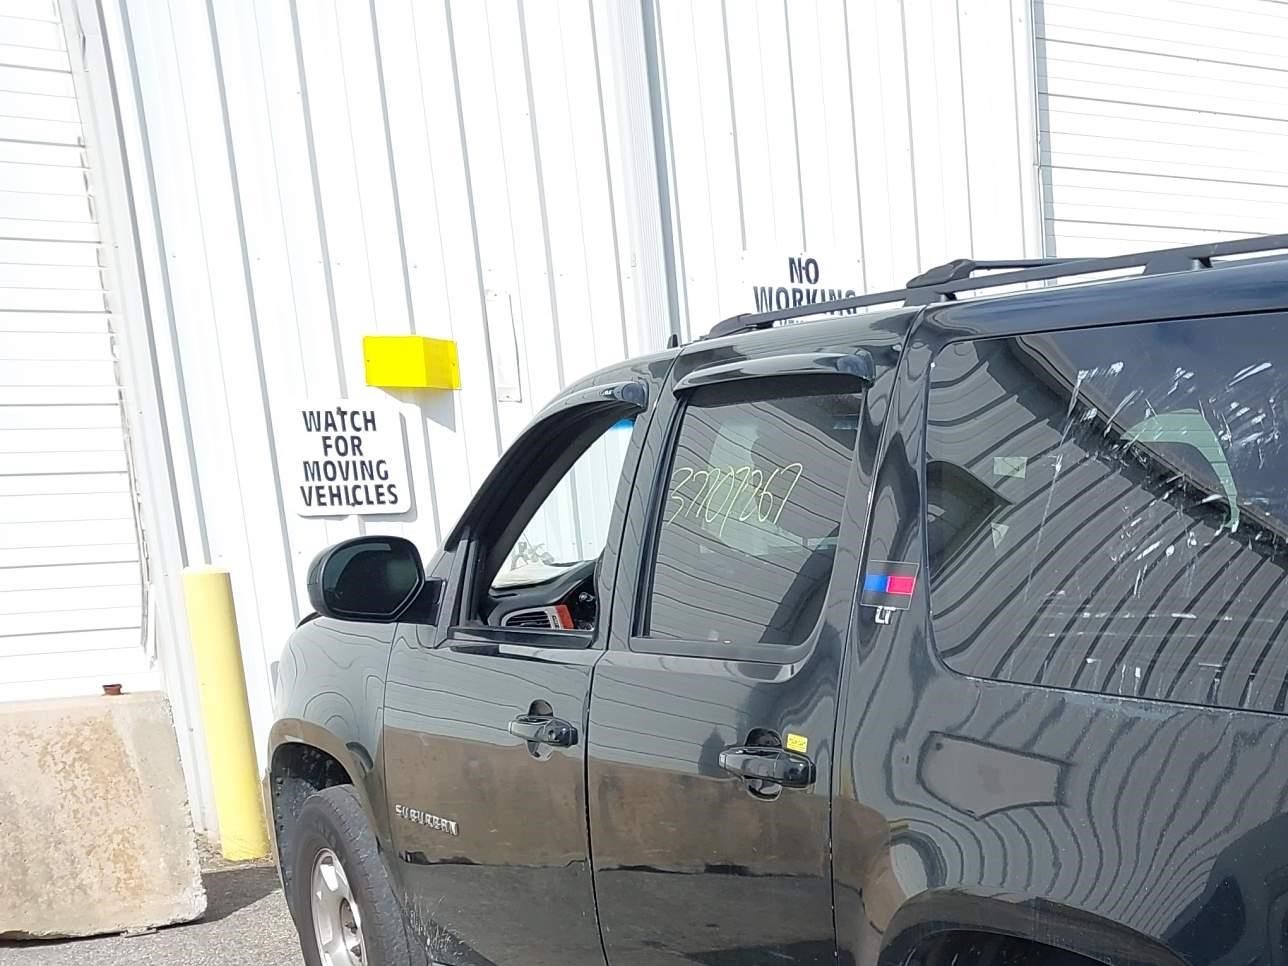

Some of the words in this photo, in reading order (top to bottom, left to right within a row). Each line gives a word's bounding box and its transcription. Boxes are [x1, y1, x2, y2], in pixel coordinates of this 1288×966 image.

[788, 256, 820, 285] NO
[302, 409, 377, 432] WATCH
[321, 435, 363, 457] FOR
[302, 459, 389, 482] MOVING
[299, 483, 399, 507] VEHICLES
[395, 804, 459, 837] SUBURBAN
